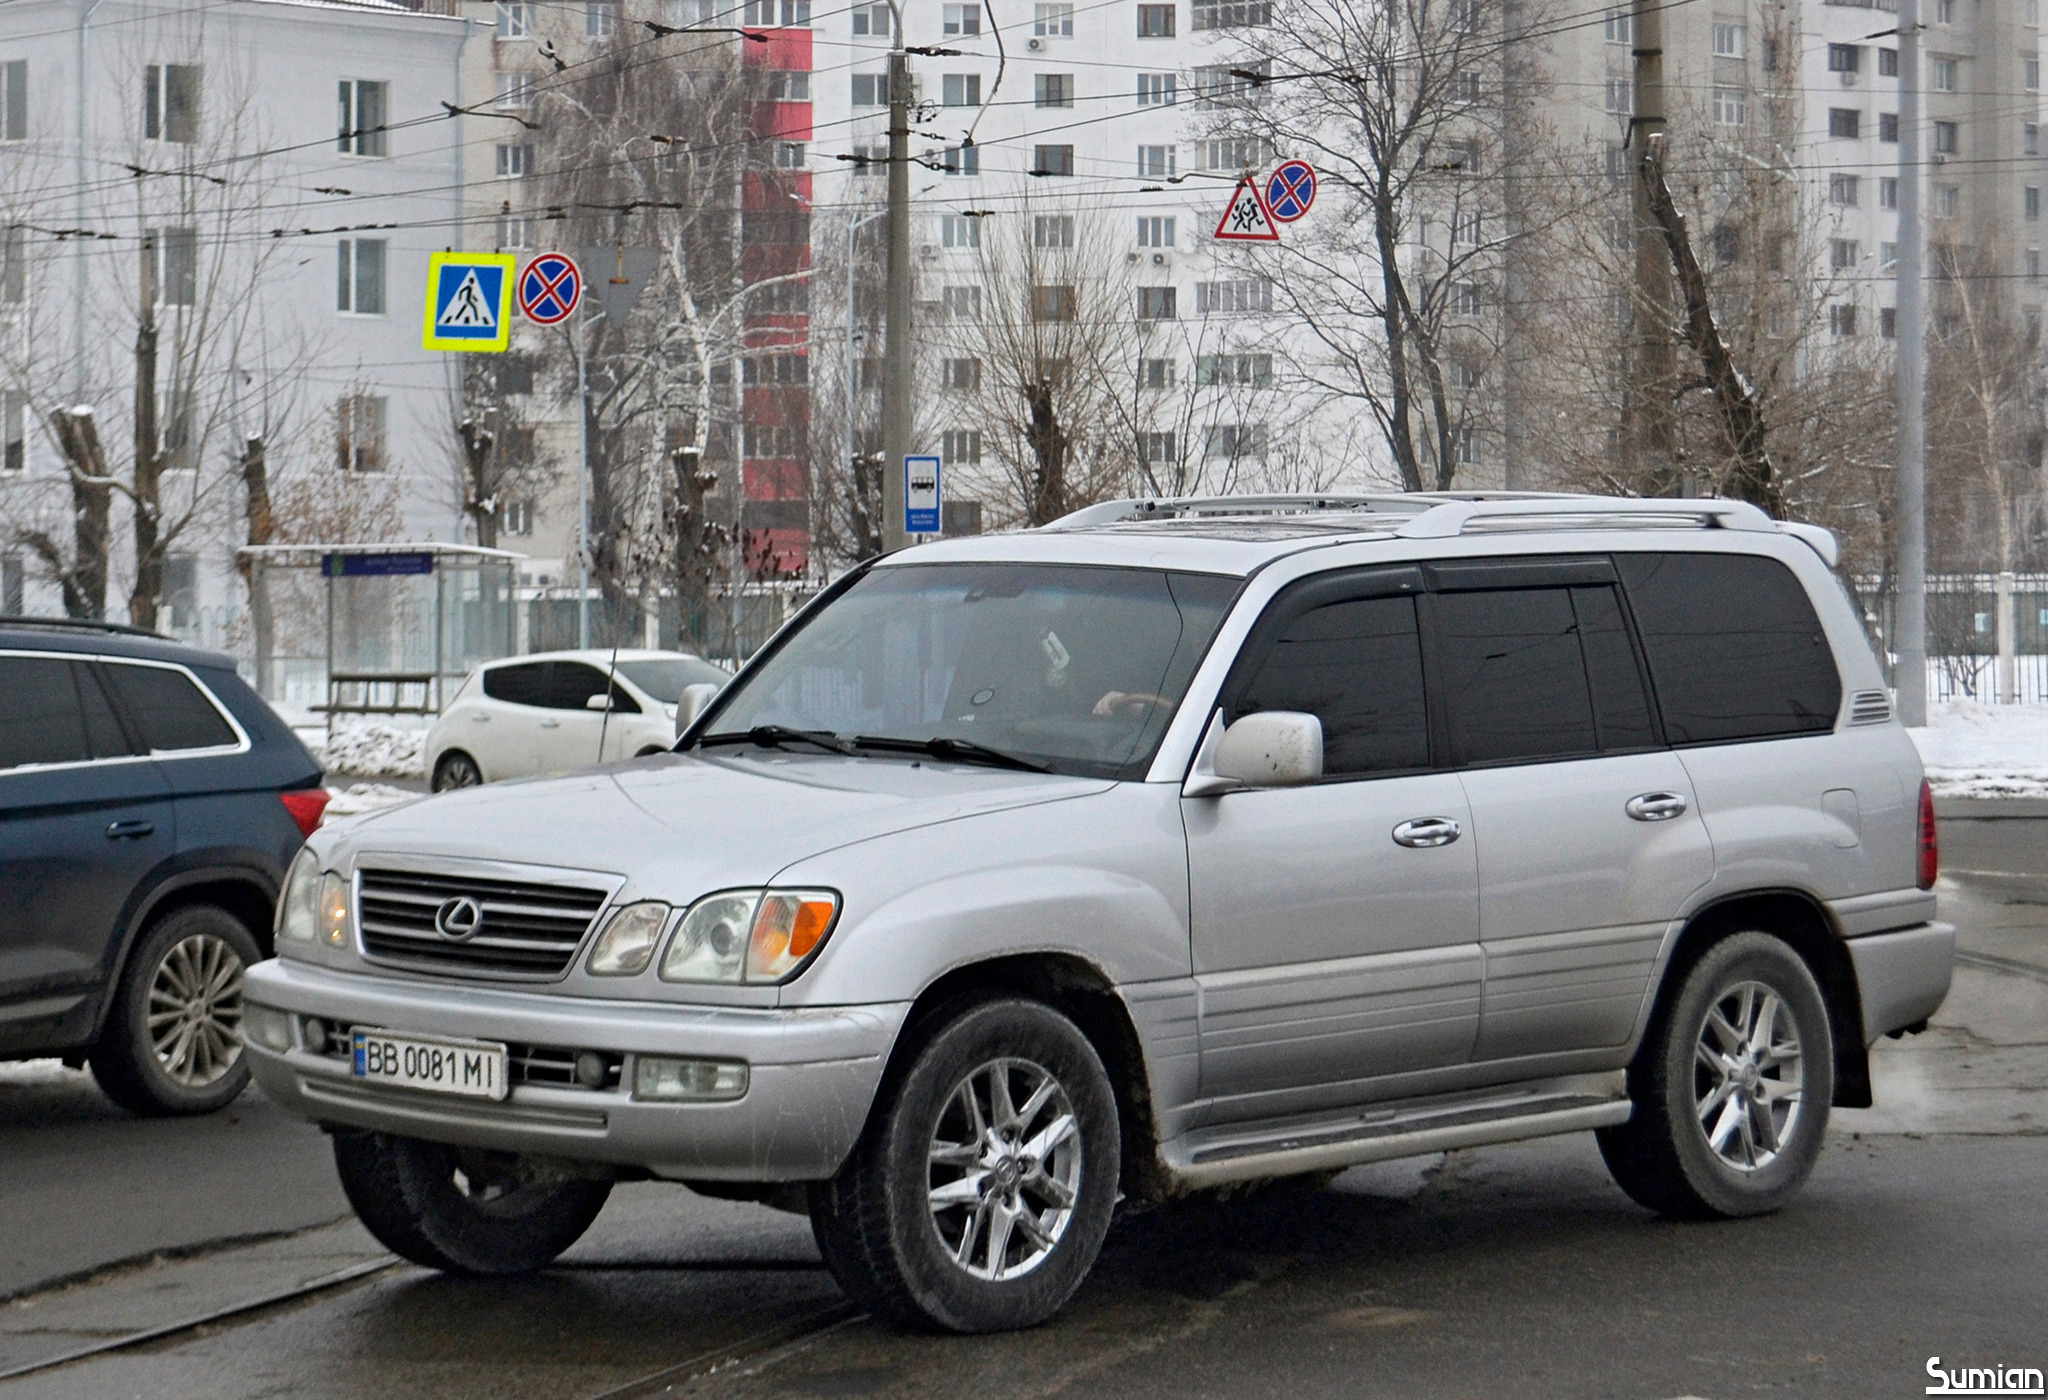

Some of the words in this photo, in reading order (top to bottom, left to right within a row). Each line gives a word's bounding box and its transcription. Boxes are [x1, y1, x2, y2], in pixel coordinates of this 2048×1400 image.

[368, 1041, 399, 1076] BB
[405, 1045, 456, 1085] 0081
[464, 1052, 493, 1088] MI
